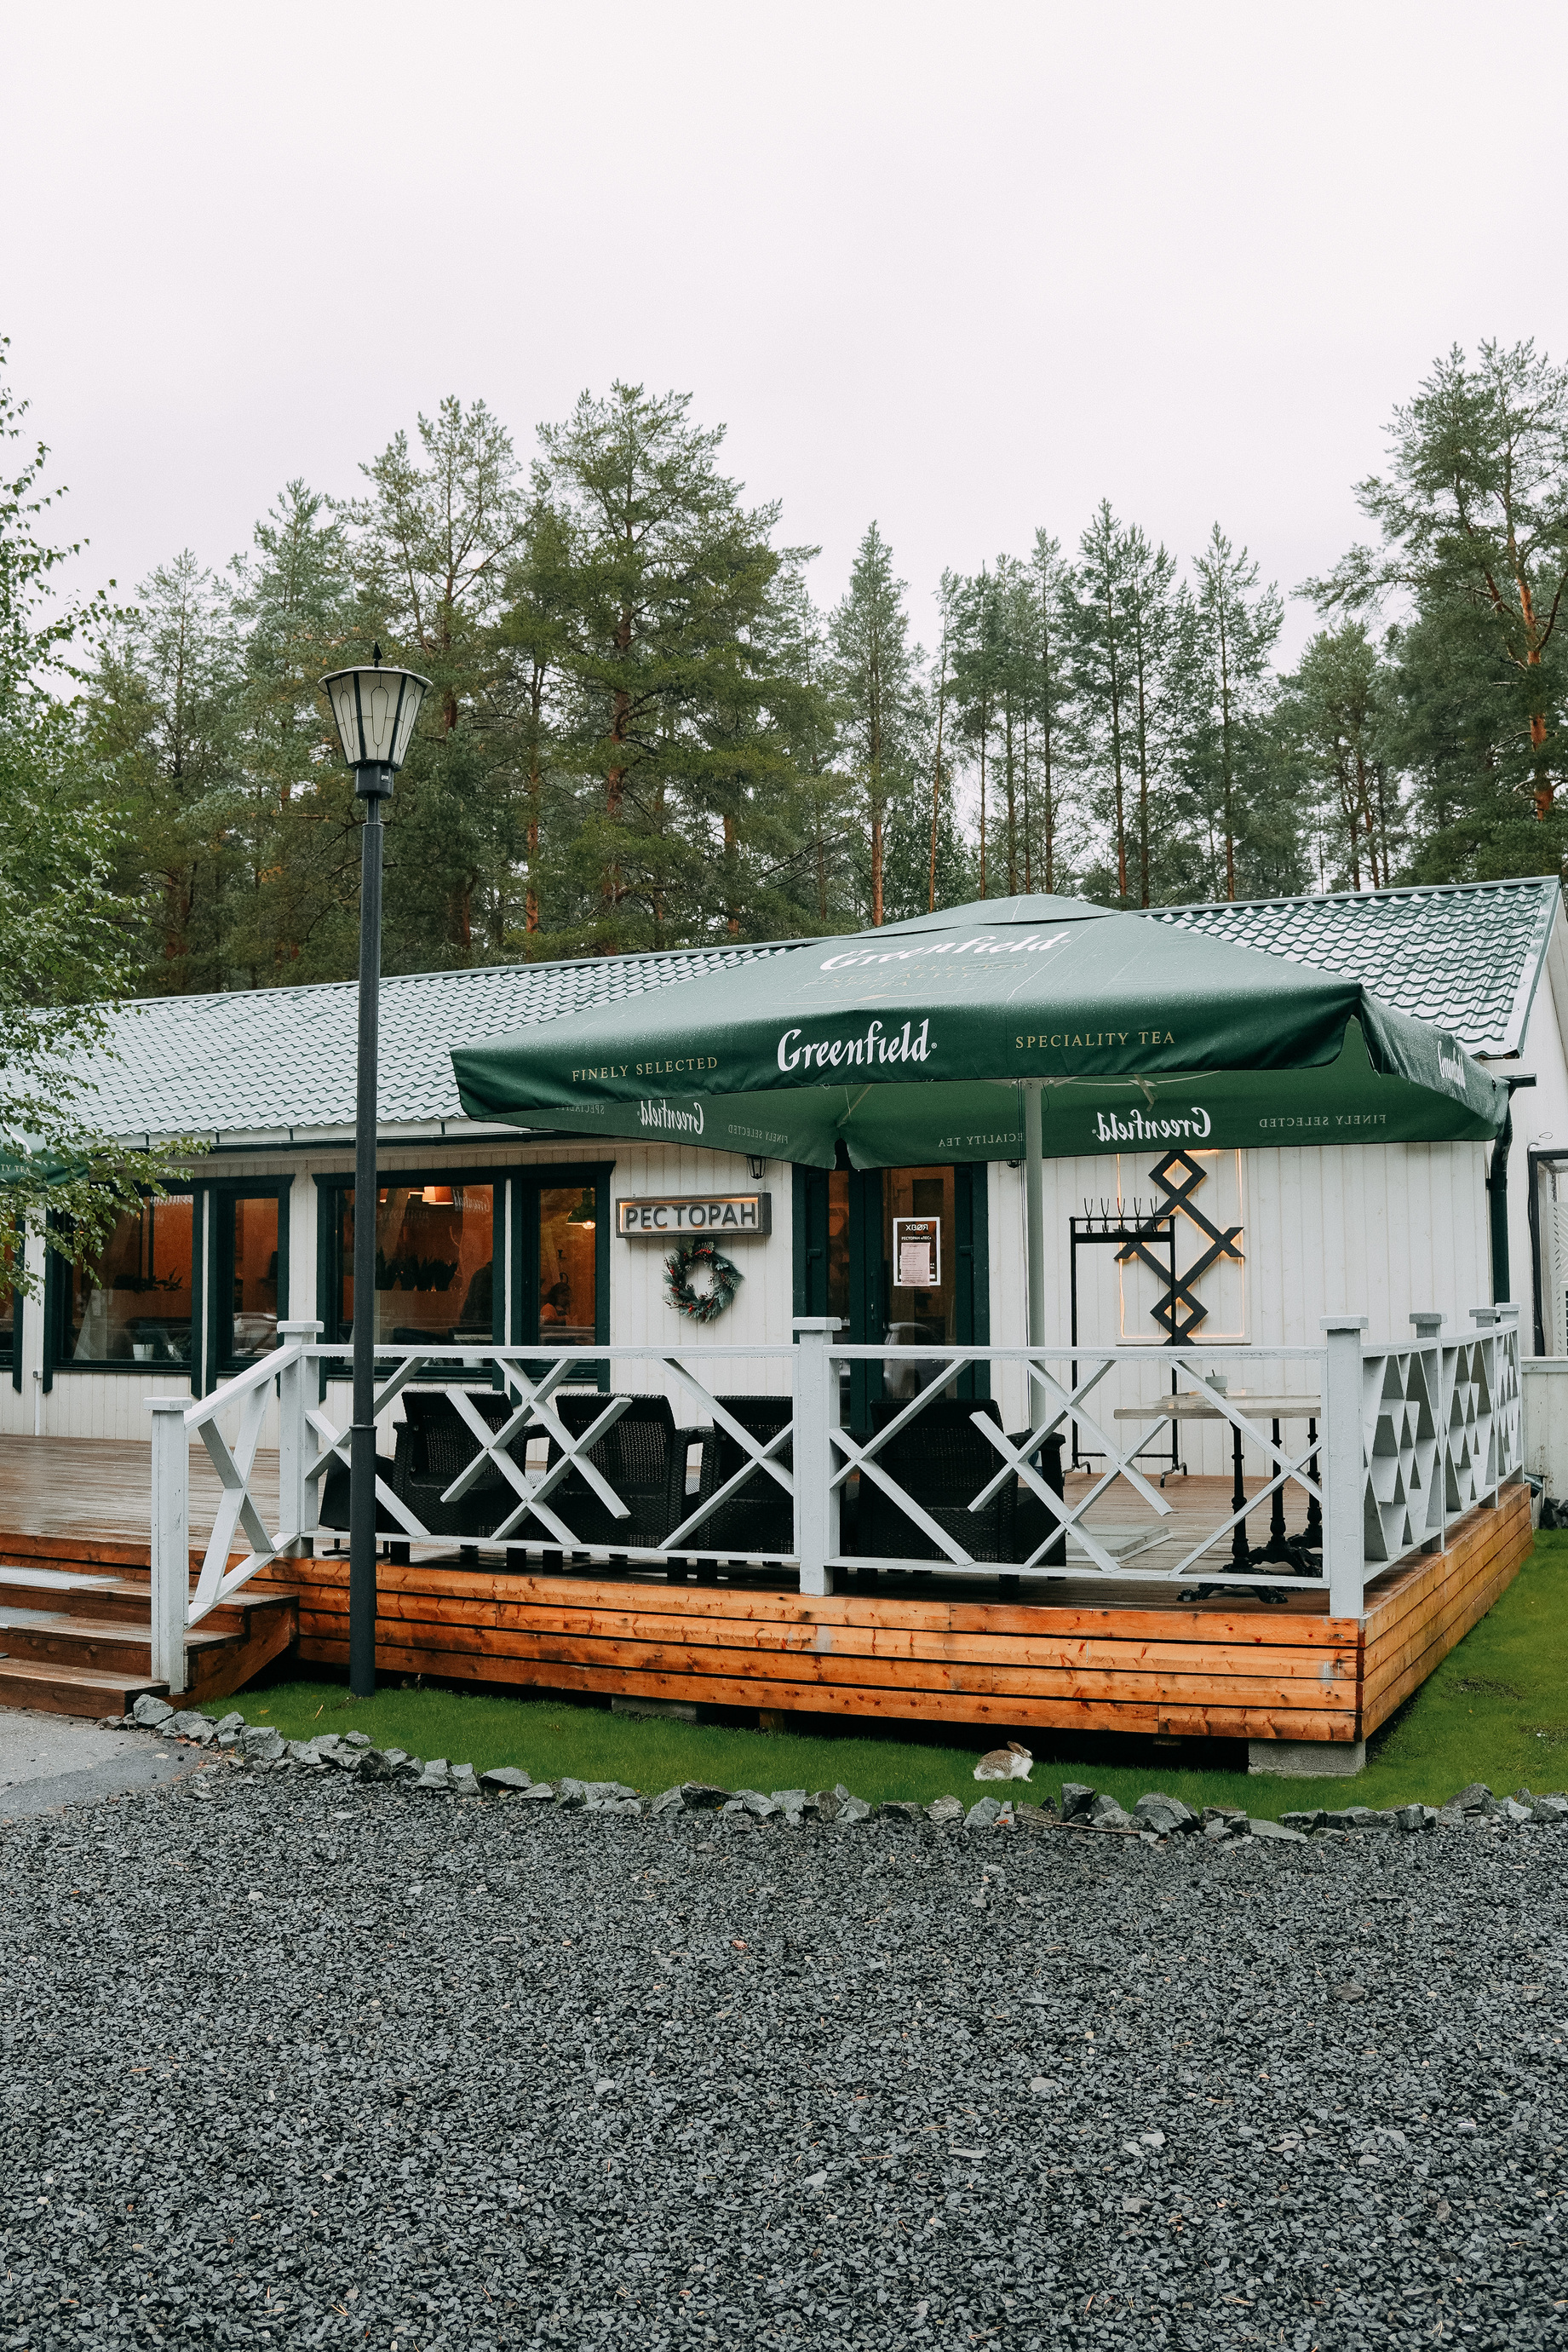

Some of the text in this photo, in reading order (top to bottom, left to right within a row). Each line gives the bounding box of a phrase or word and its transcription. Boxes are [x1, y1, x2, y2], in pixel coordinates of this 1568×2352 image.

[819, 931, 1071, 970] Greenfield
[777, 1019, 931, 1072] Greenfield
[1015, 1031, 1175, 1049] SPECIALITY TEA
[571, 1056, 718, 1083] FINELY SELECTED
[625, 1202, 756, 1230] РЕСТОРАН
